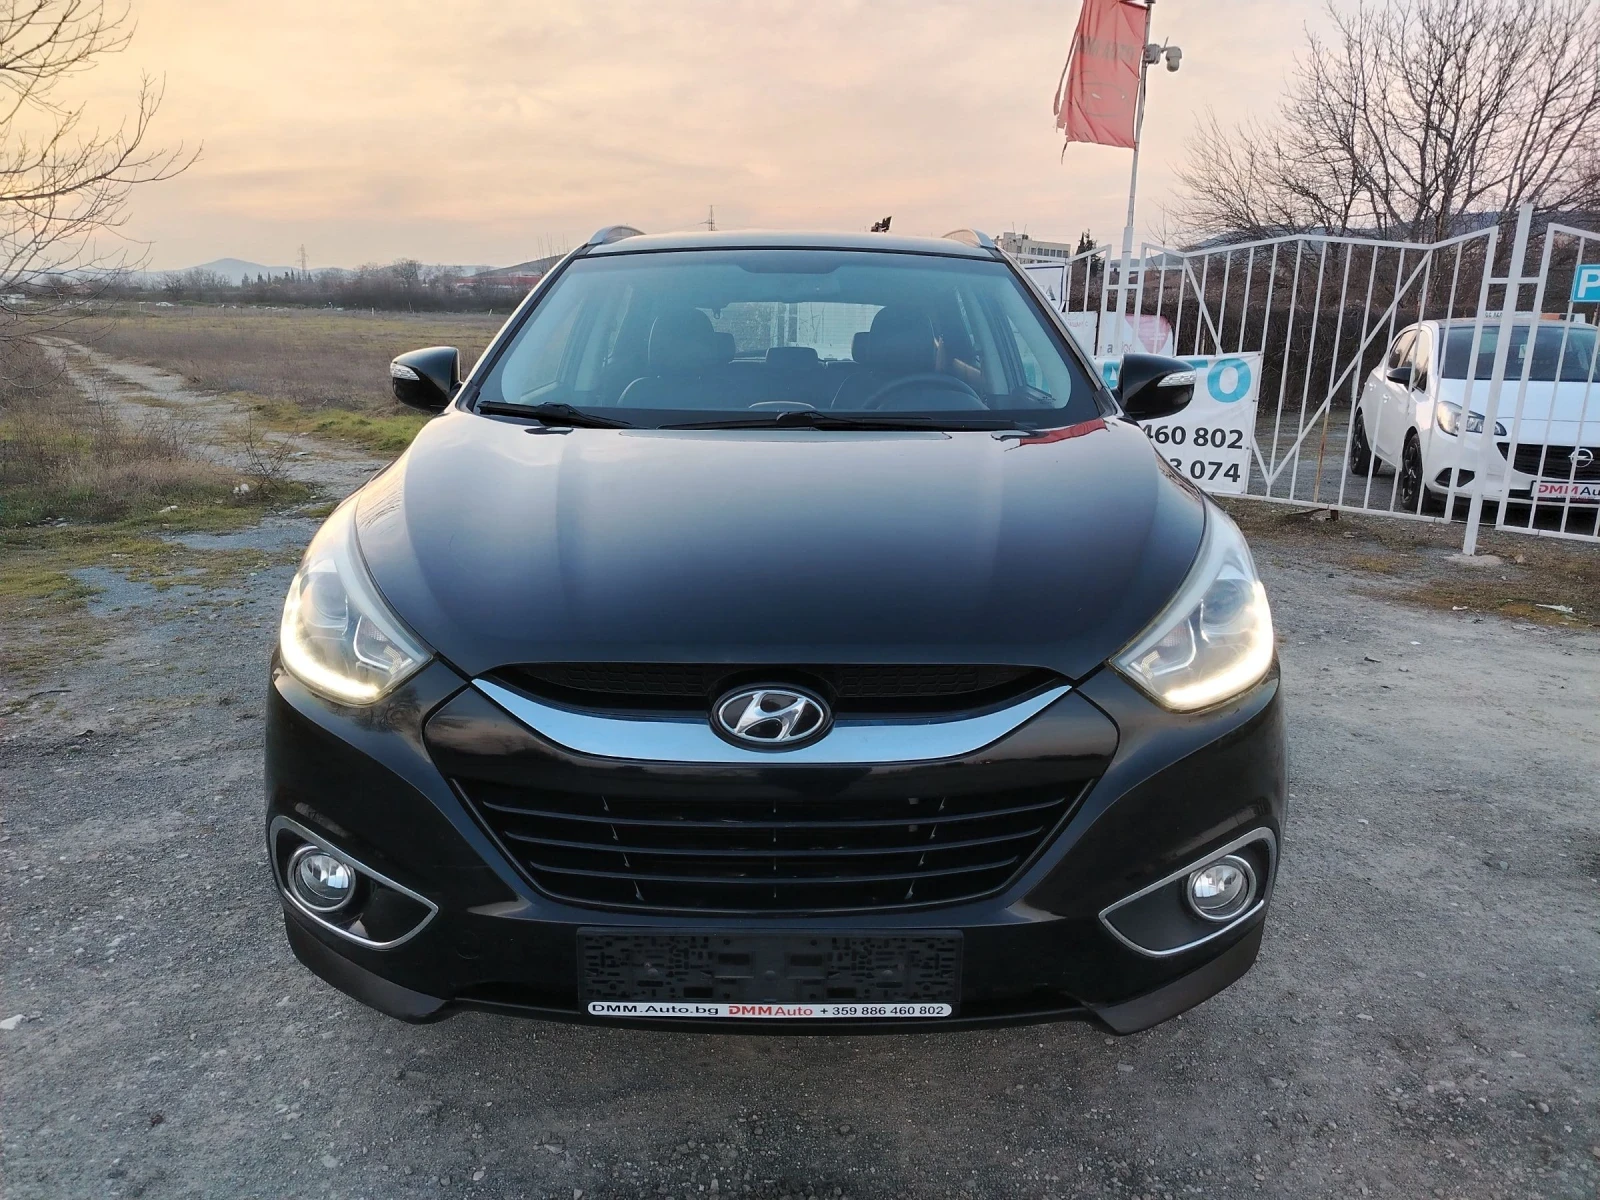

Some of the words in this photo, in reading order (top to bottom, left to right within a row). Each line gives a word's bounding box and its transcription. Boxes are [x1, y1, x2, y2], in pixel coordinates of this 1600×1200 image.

[1577, 269, 1600, 298] P
[1193, 427, 1244, 450] 802
[1190, 460, 1241, 483] 074
[832, 1006, 857, 1016] 359
[861, 1006, 887, 1016] 886
[890, 1006, 915, 1016] 460
[919, 1006, 944, 1015] 802
